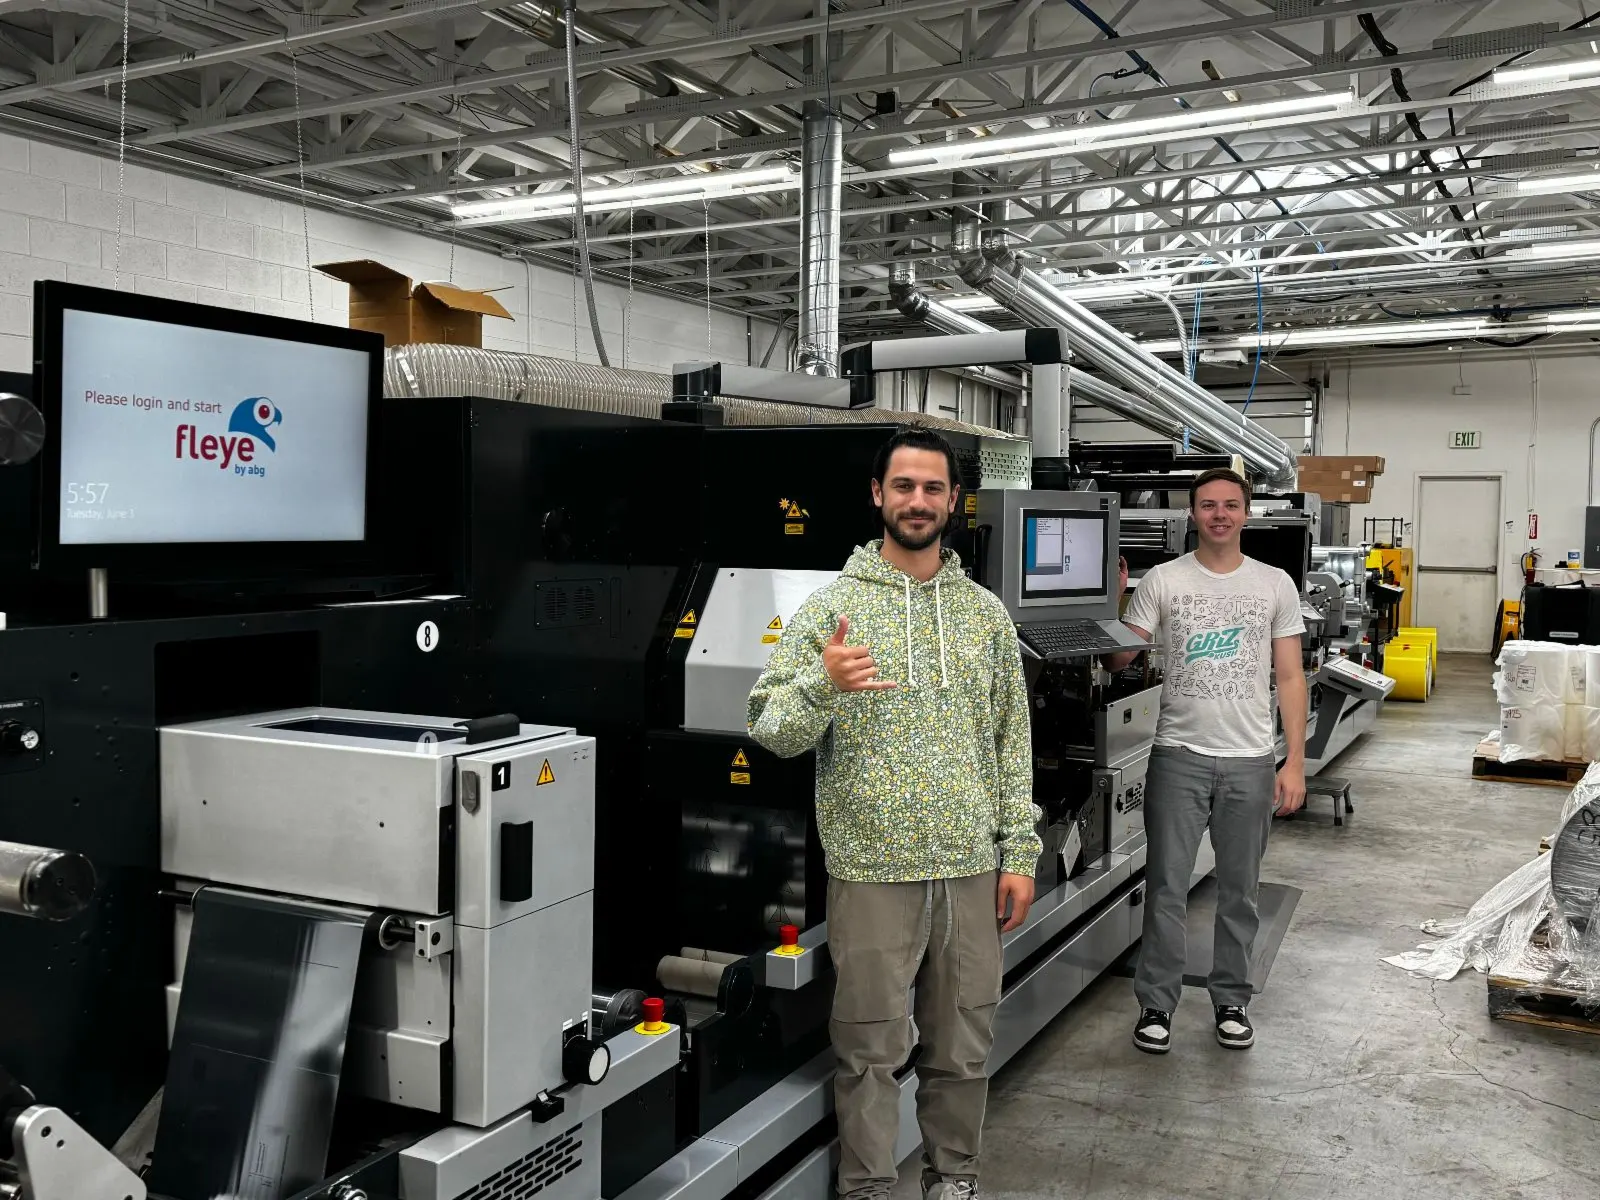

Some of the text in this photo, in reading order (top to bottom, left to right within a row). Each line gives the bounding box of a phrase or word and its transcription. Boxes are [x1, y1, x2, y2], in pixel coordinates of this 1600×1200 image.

[85, 390, 222, 414] Please login and start
[176, 424, 255, 470] fleye
[1455, 432, 1476, 447] EXIT
[234, 464, 265, 477] by abg
[67, 482, 109, 504] 5:57
[424, 625, 431, 648] 8
[497, 766, 505, 786] 1
